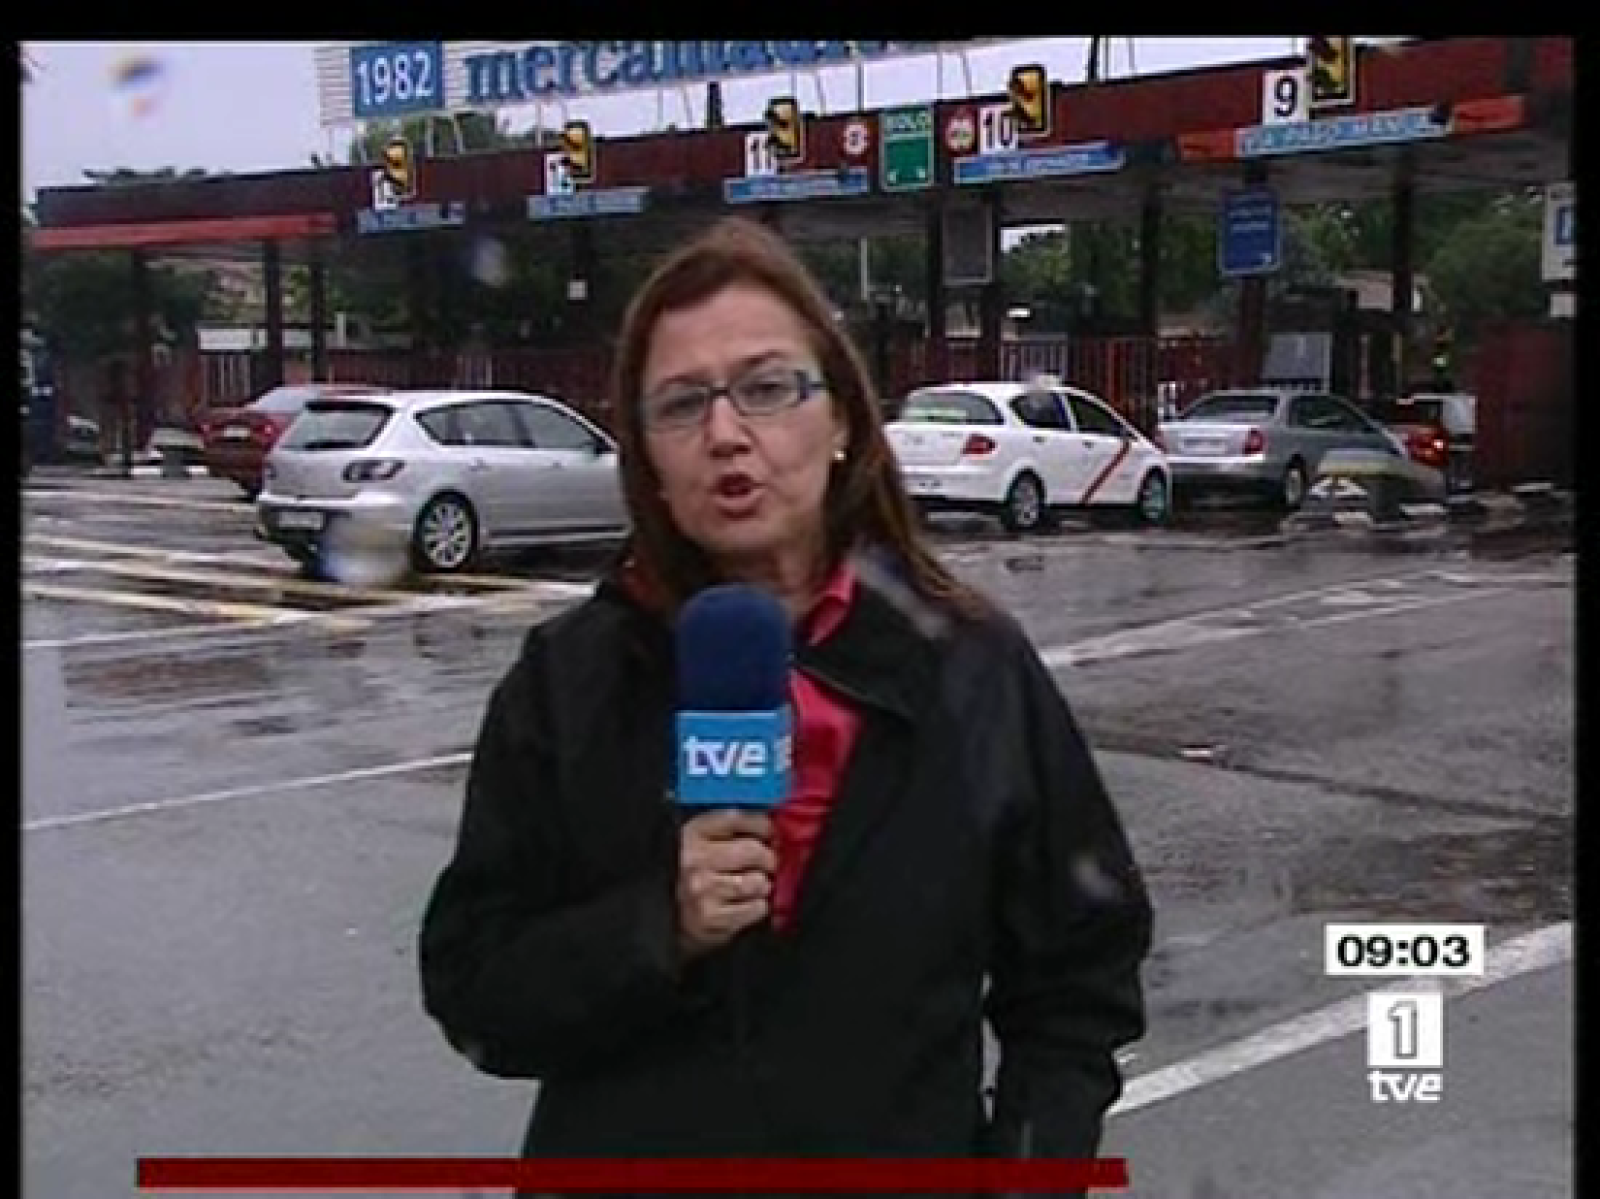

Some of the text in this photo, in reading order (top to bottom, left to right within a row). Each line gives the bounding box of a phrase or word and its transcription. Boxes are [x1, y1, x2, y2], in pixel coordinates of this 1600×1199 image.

[357, 50, 434, 105] 1982
[1273, 76, 1299, 118] 9
[682, 735, 768, 778] tve
